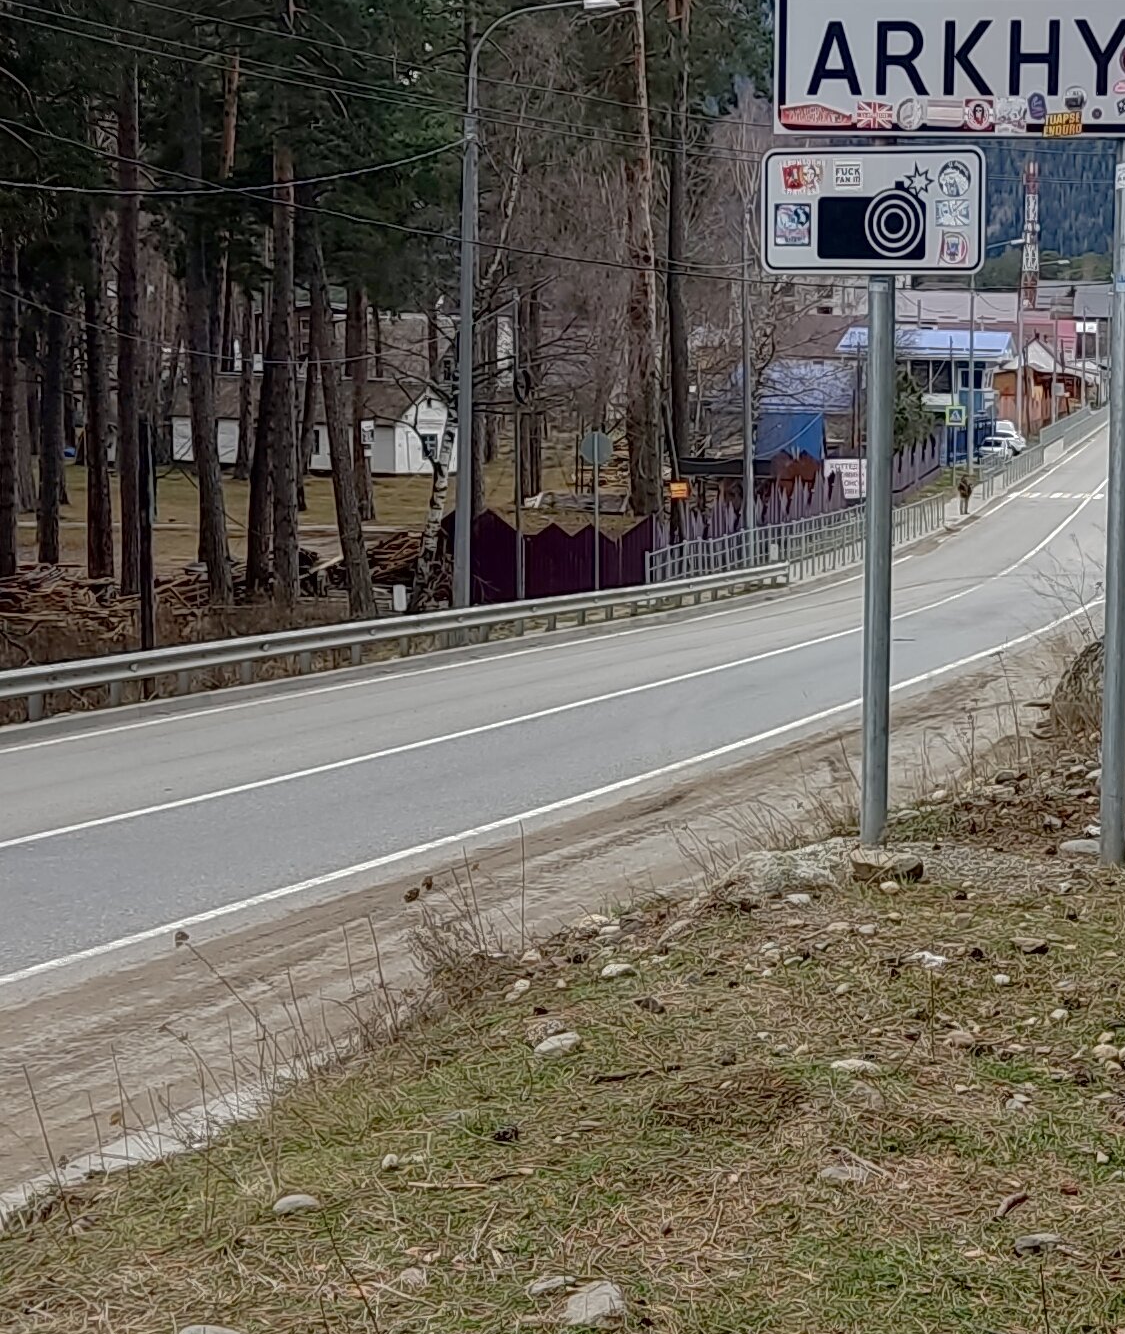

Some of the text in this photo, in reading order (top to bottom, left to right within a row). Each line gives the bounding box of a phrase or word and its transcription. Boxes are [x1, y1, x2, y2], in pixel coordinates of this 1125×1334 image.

[1045, 112, 1081, 125] TUAPSE
[1043, 124, 1082, 137] ENDURO
[836, 168, 860, 176] FUCK
